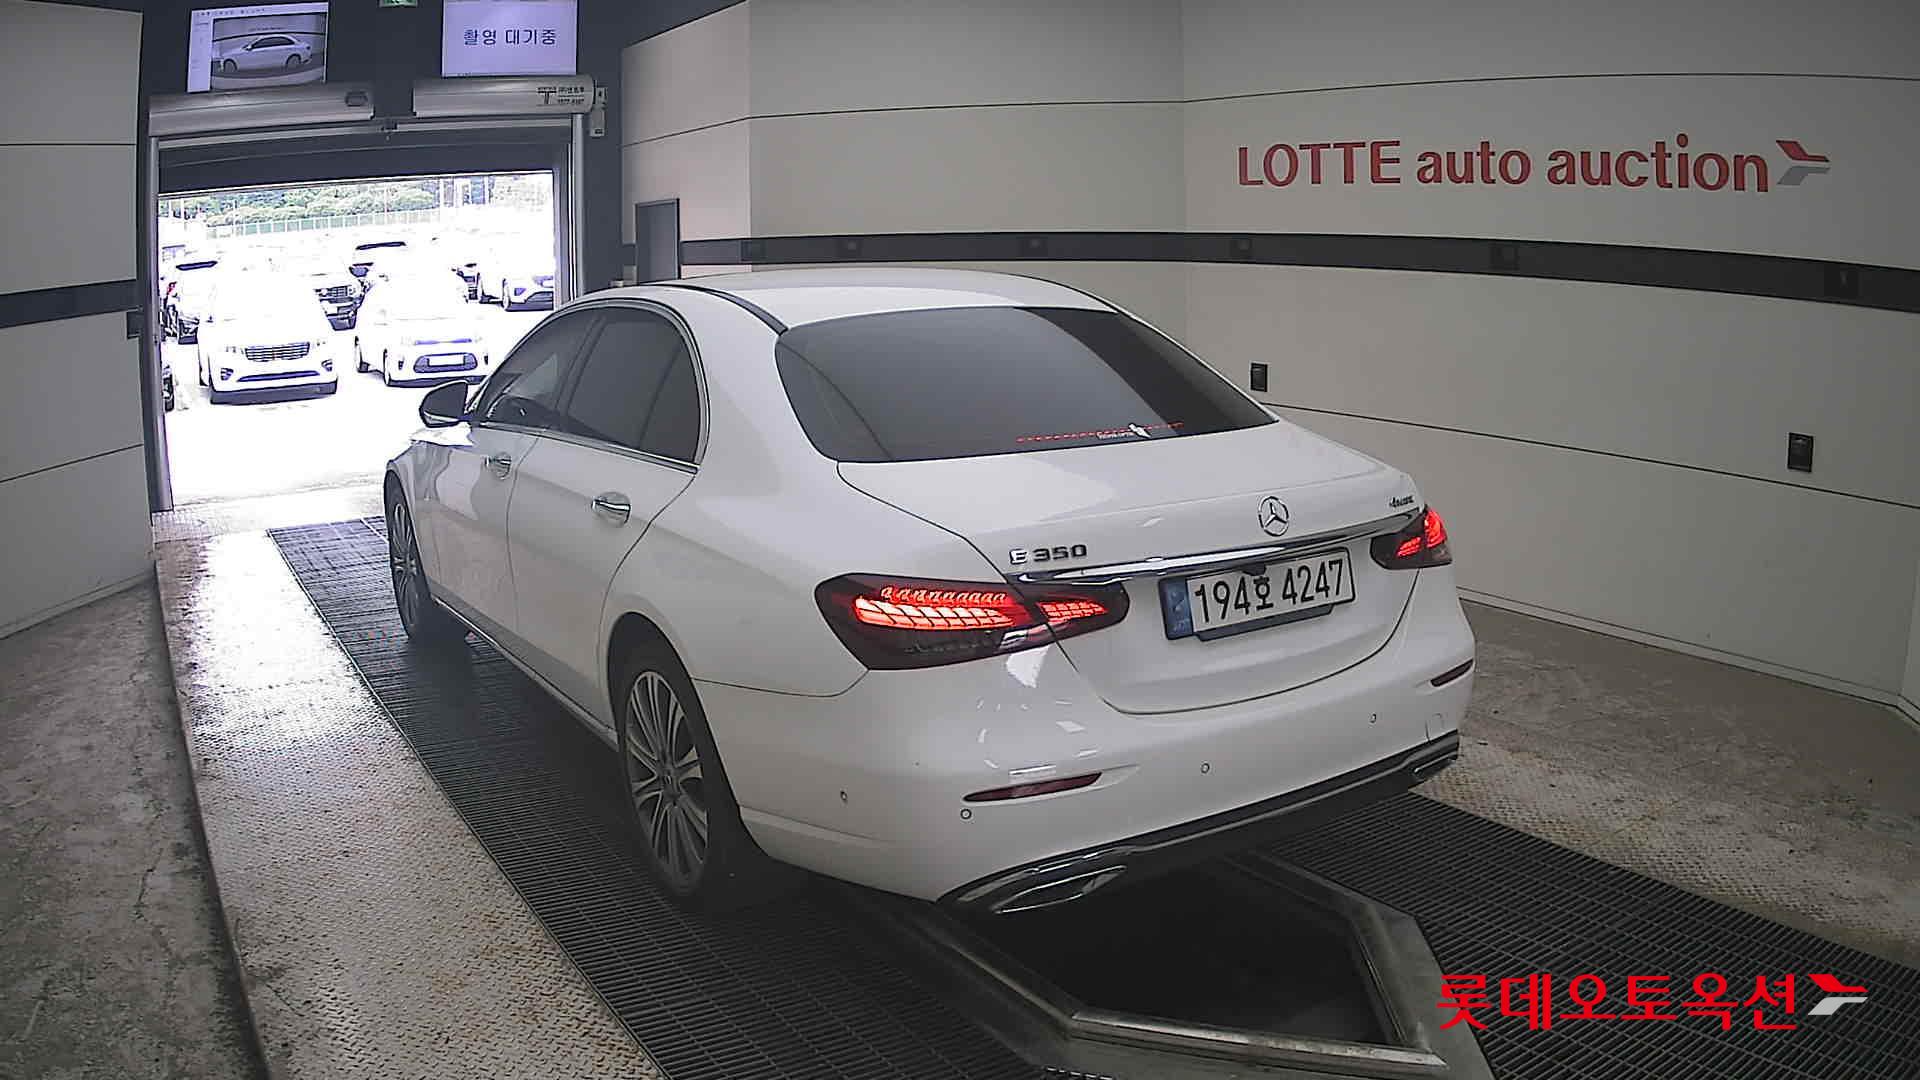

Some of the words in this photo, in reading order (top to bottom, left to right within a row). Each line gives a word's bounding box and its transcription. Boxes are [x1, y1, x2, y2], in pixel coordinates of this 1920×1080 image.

[463, 28, 497, 46] 촬영
[505, 28, 556, 46] 대기중
[1238, 140, 1401, 187] LOTTE
[1416, 139, 1532, 186] auto
[1547, 133, 1770, 192] auction
[1009, 548, 1028, 565] E
[1033, 544, 1087, 562] 350
[1195, 576, 1274, 624] 194호
[1282, 559, 1343, 605] 4247
